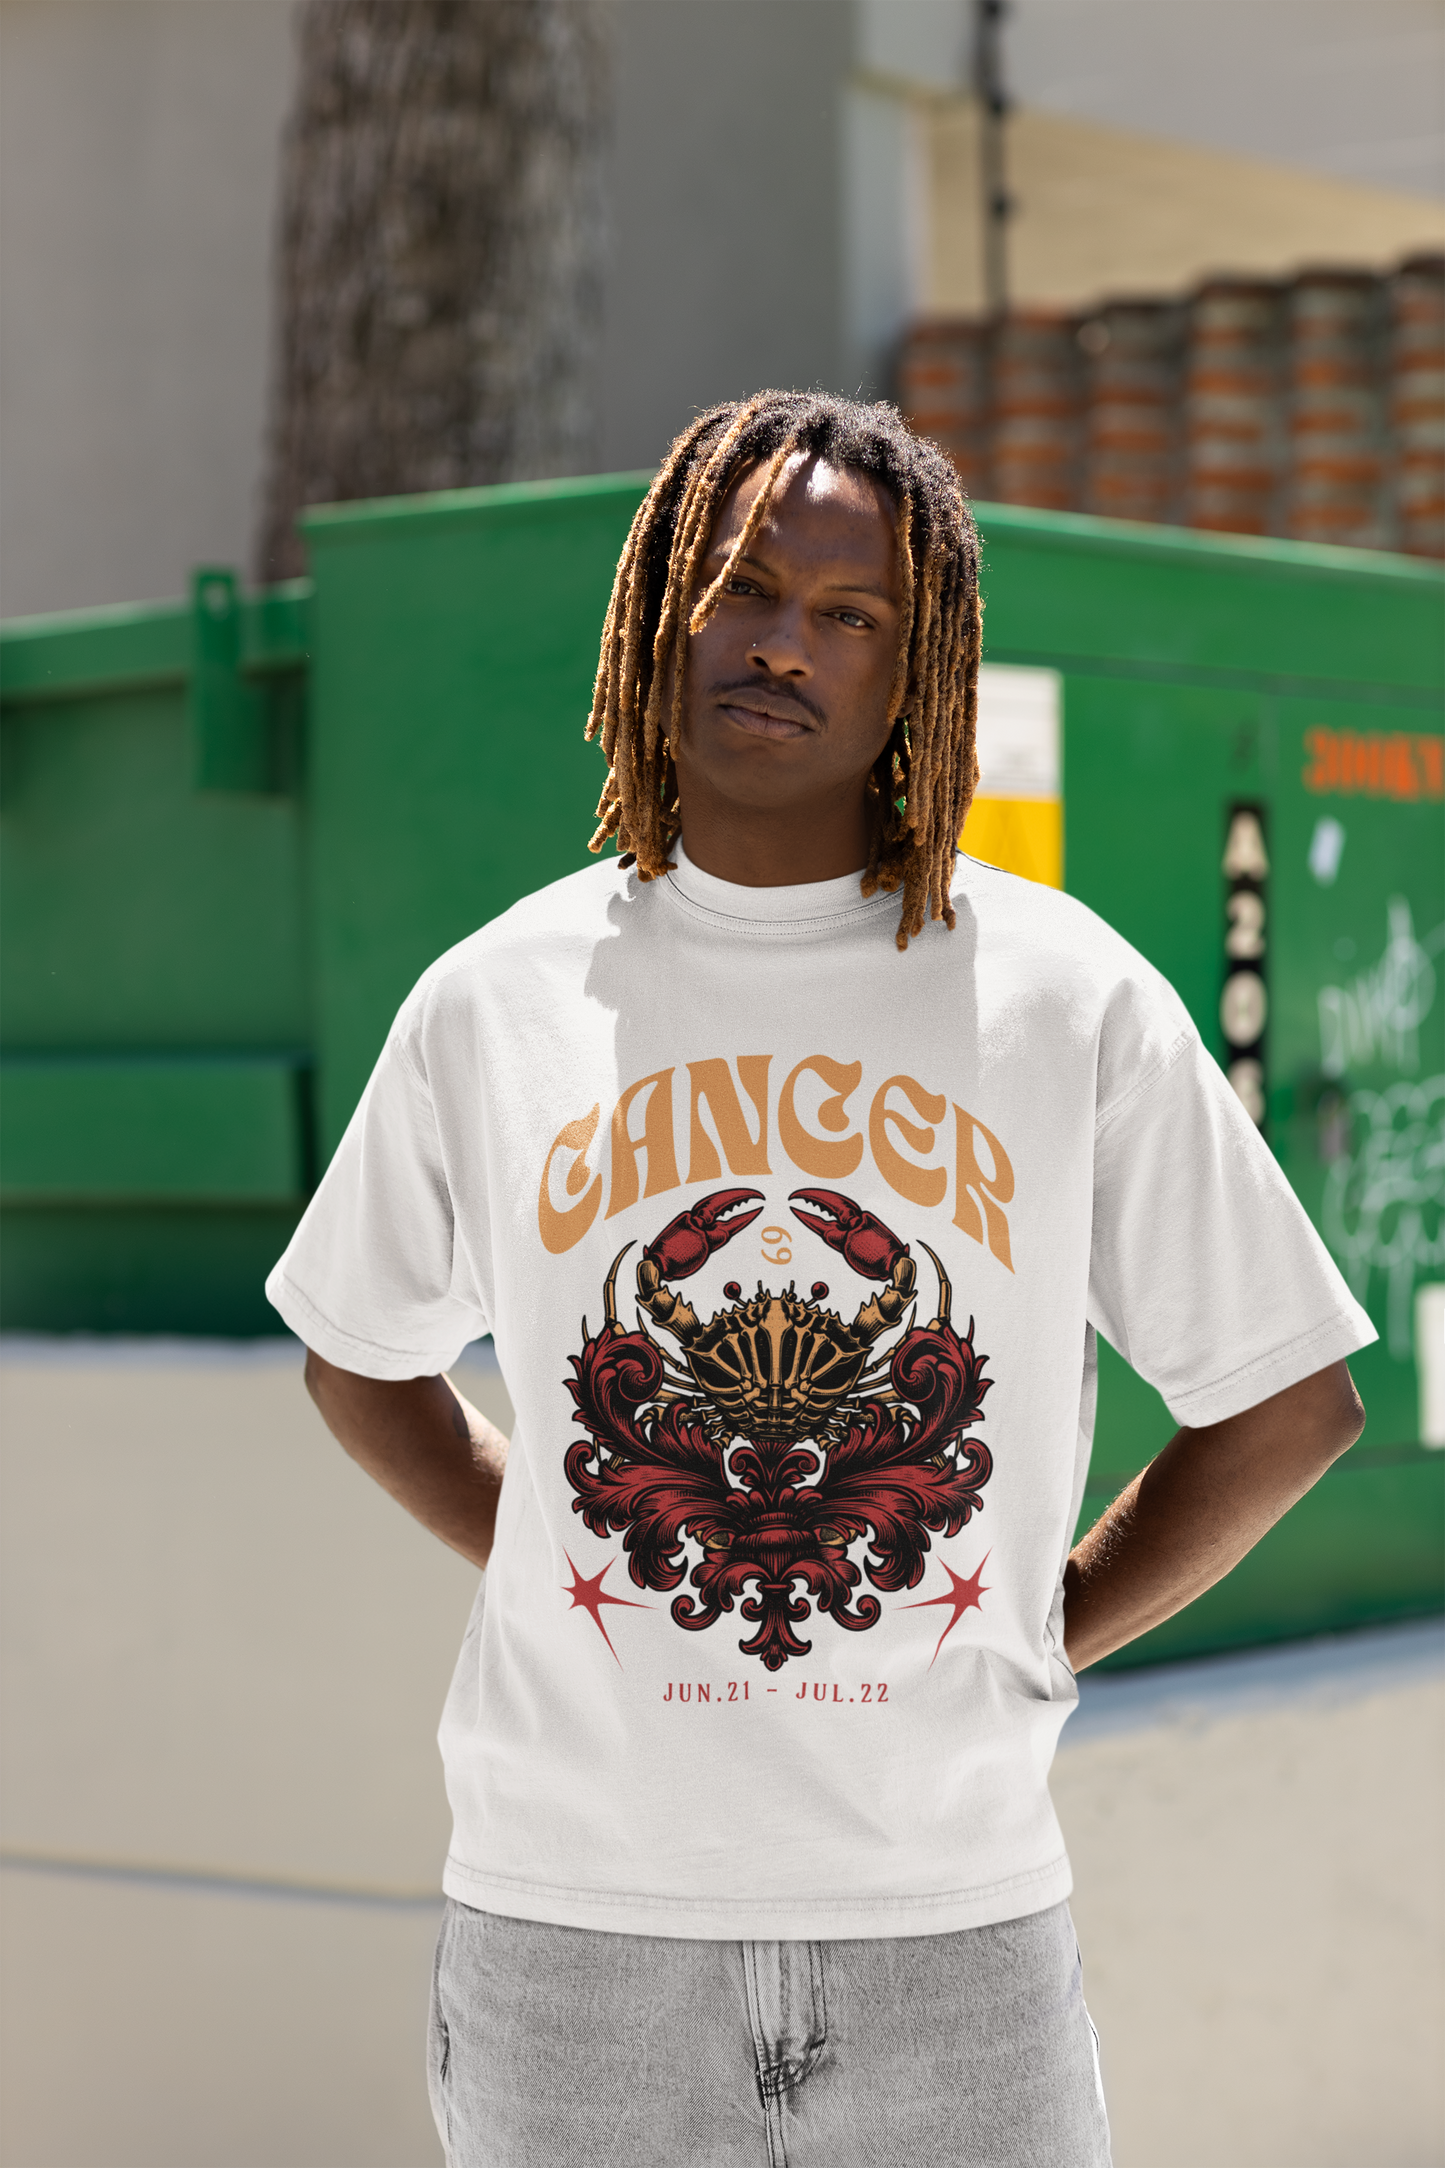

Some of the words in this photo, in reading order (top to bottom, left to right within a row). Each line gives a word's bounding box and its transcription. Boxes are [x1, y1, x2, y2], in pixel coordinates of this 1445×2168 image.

[538, 1054, 1015, 1275] CANCER
[663, 1681, 750, 1702] JUN.21
[796, 1682, 889, 1702] JUL.22
